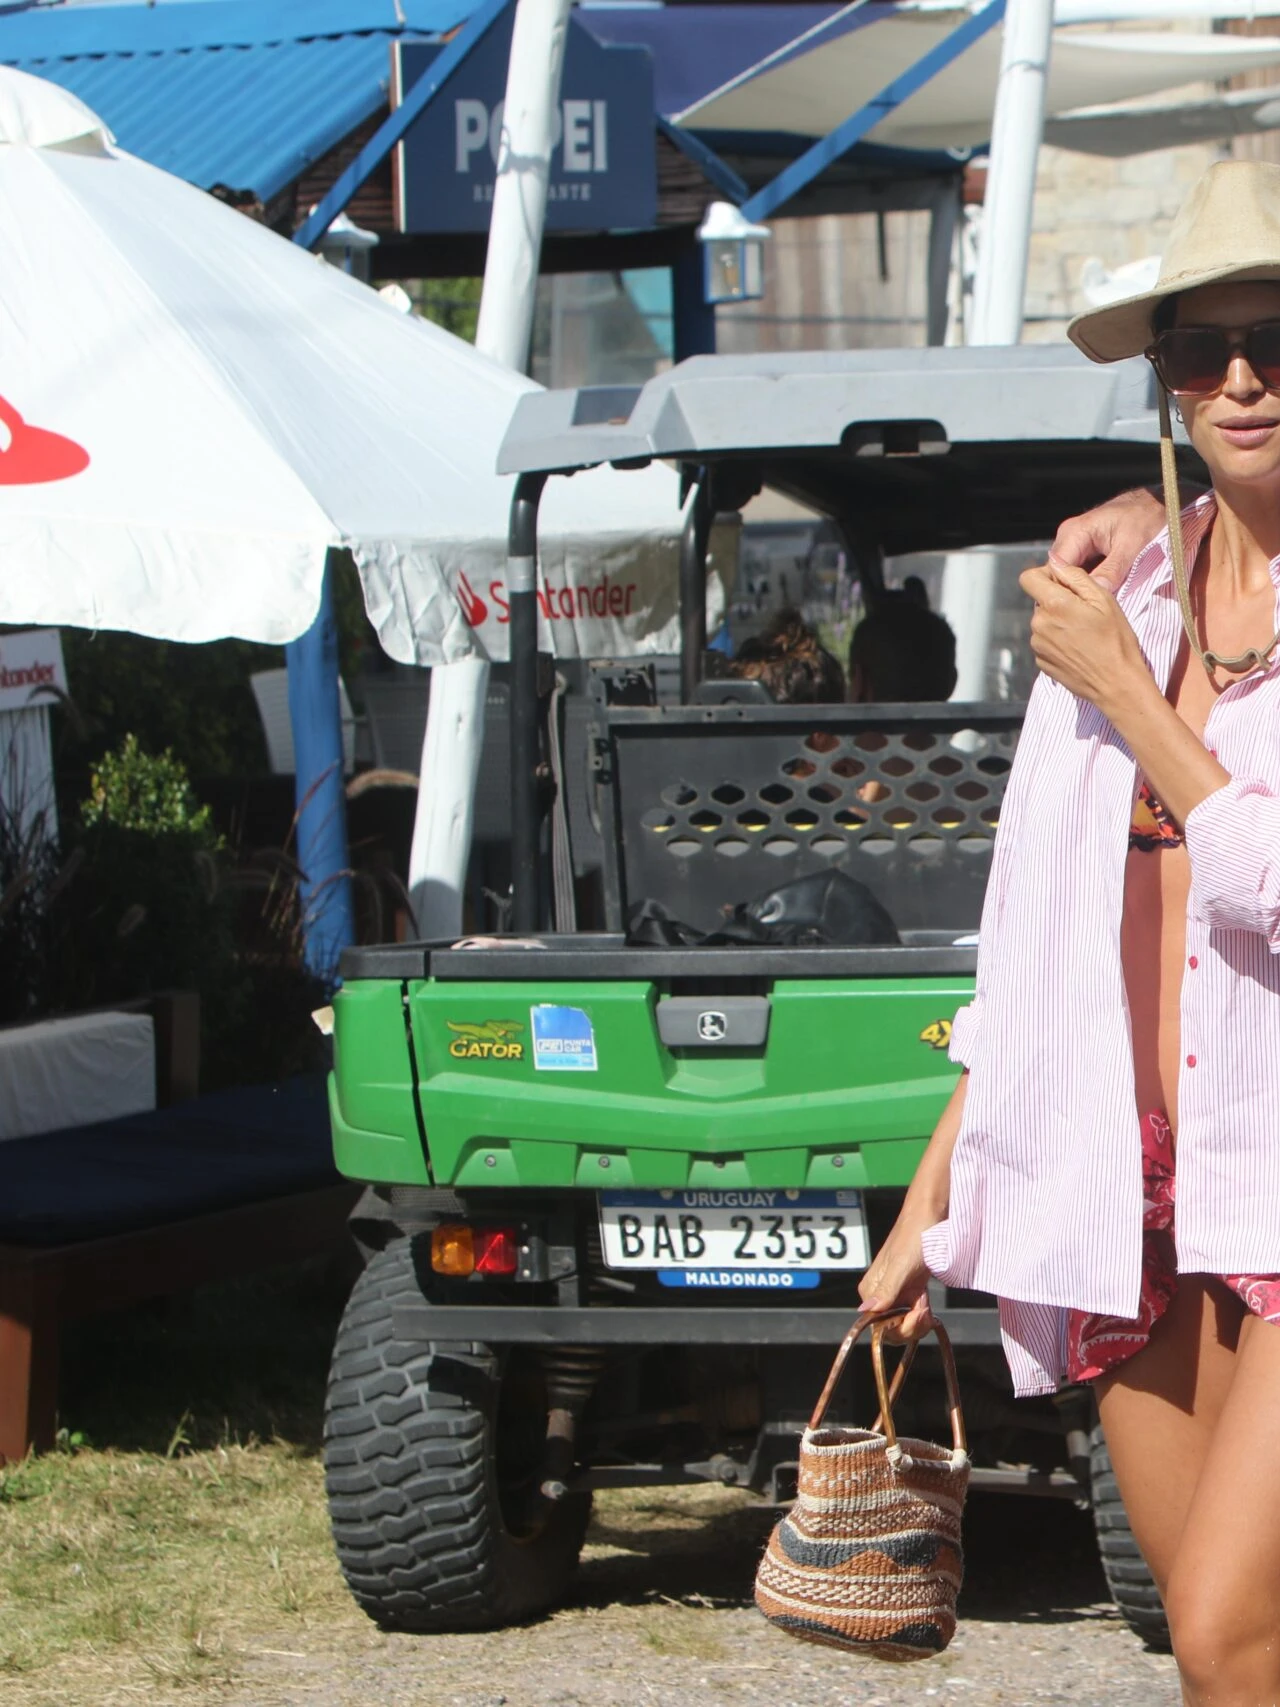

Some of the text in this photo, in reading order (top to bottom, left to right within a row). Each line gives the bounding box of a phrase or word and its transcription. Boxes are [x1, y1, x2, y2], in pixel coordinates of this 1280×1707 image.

[489, 575, 637, 623] Sntander
[0, 658, 55, 688] tander
[450, 1038, 523, 1059] GATOR
[683, 1192, 777, 1207] URUGUAY
[617, 1213, 849, 1260] BAB 2353
[685, 1272, 793, 1287] MALDONADO
